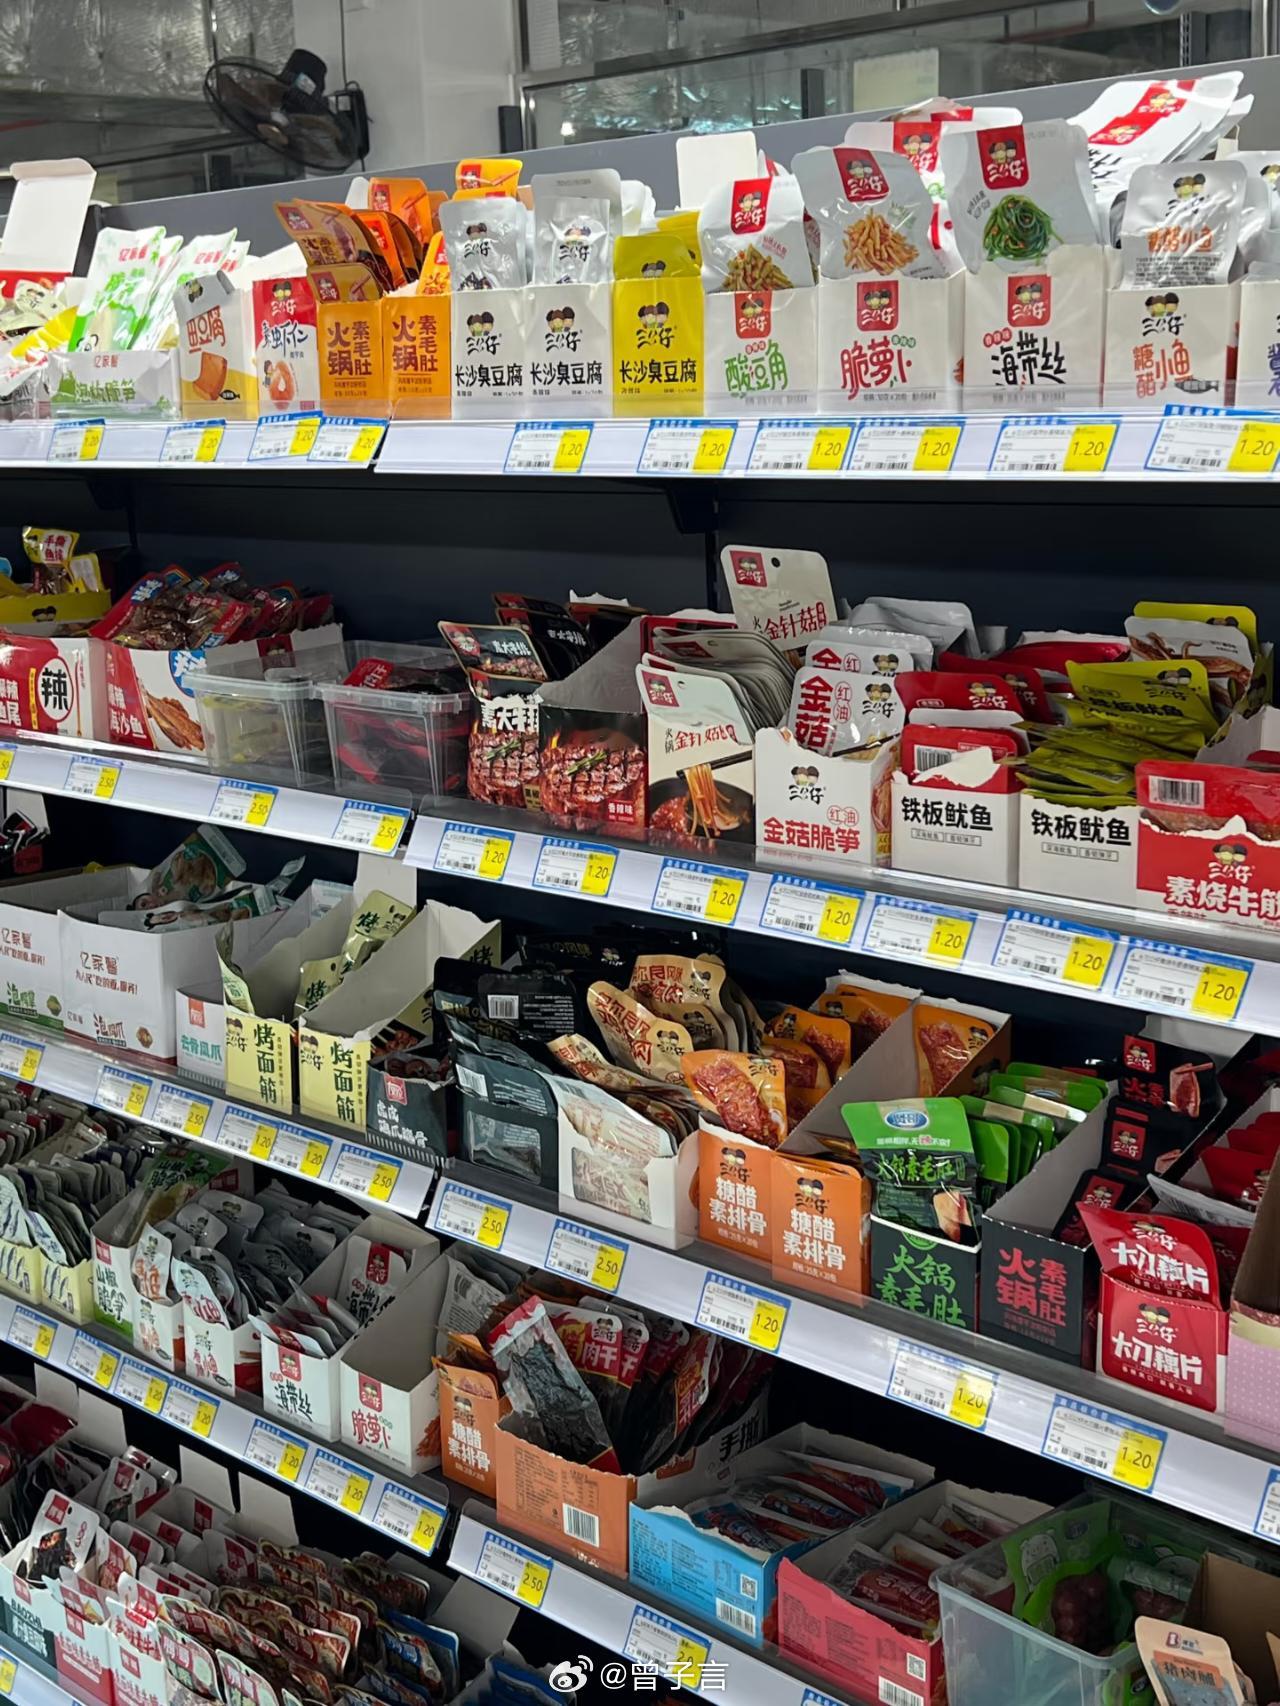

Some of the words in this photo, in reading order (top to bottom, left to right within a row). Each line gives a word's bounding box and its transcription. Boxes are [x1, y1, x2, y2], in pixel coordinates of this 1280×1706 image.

[987, 159, 1024, 181] 三公仔
[847, 176, 885, 197] 三公仔
[733, 211, 764, 228] 三公仔
[559, 244, 590, 262] 三公仔
[271, 300, 297, 316] 三公仔
[861, 308, 894, 325] 三公仔
[1012, 302, 1047, 320] 三公仔
[739, 315, 768, 333] 三公仔
[1142, 316, 1184, 337] 三公仔
[328, 322, 353, 376] 火锅
[352, 321, 373, 375] 素毛肚
[392, 315, 416, 371] 火锅
[418, 315, 438, 372] 素毛肚
[466, 335, 500, 356] 三公仔
[546, 331, 580, 353] 三公仔
[637, 328, 674, 350] 三公仔
[724, 339, 788, 393] 酸豆角
[840, 336, 912, 400] 脆萝卜
[991, 330, 1068, 388] 海带丝
[455, 363, 524, 388] 长沙臭豆腐
[530, 360, 603, 386] 长沙臭豆腐
[619, 357, 697, 385] 长沙臭豆腐
[296, 429, 315, 442] 1.20
[357, 437, 377, 450] 1.20
[560, 443, 583, 456] 1.20
[700, 442, 725, 456] 1.20
[815, 442, 842, 456] 1.20
[921, 442, 950, 456] 1.20
[1072, 441, 1104, 456] 1.20
[1239, 439, 1275, 456] 1.20
[41, 667, 69, 710] 辣
[863, 700, 897, 719] 三公仔
[789, 784, 825, 805] 三公仔
[250, 802, 268, 816] 2.50
[827, 806, 858, 826] 红油
[901, 796, 993, 832] 铁板鱿鱼
[377, 826, 398, 840] 2.50
[763, 816, 860, 854] 金菇脆笋
[1031, 808, 1131, 847] 铁板鱿鱼
[484, 849, 505, 865] 1.20
[587, 864, 610, 880] 1.20
[1208, 861, 1253, 885] 三公仔
[712, 890, 736, 907] 1.20
[825, 907, 852, 926] 1.20
[934, 931, 962, 949] 1.20
[1072, 950, 1103, 971] 1.20
[1201, 980, 1236, 1001] 1.20
[253, 1023, 278, 1105] 烤面筋
[330, 1040, 356, 1123] 烤面筋
[188, 1112, 204, 1127] 2.50
[255, 1134, 272, 1150] 1.20
[373, 1173, 392, 1189] 2.50
[720, 1162, 751, 1183] 三公仔
[715, 1176, 758, 1207] 糖醋
[795, 1190, 828, 1214] 三公仔
[482, 1216, 502, 1233] 2.50
[709, 1199, 767, 1239] 素排骨
[790, 1206, 836, 1244] 糖醋
[782, 1230, 846, 1272] 素排骨
[597, 1257, 618, 1276] 2.50
[885, 1244, 957, 1294] 火锅
[995, 1247, 1037, 1315] 火锅
[1038, 1257, 1068, 1327] 素毛肚
[754, 1312, 780, 1334] 1.20
[1136, 1318, 1178, 1343] 三公仔
[958, 1387, 984, 1409] 1.20
[451, 1419, 483, 1450] 糖醋
[447, 1437, 491, 1474] 素排骨
[1122, 1446, 1152, 1470] 1.20
[522, 1571, 543, 1594] 2.50
